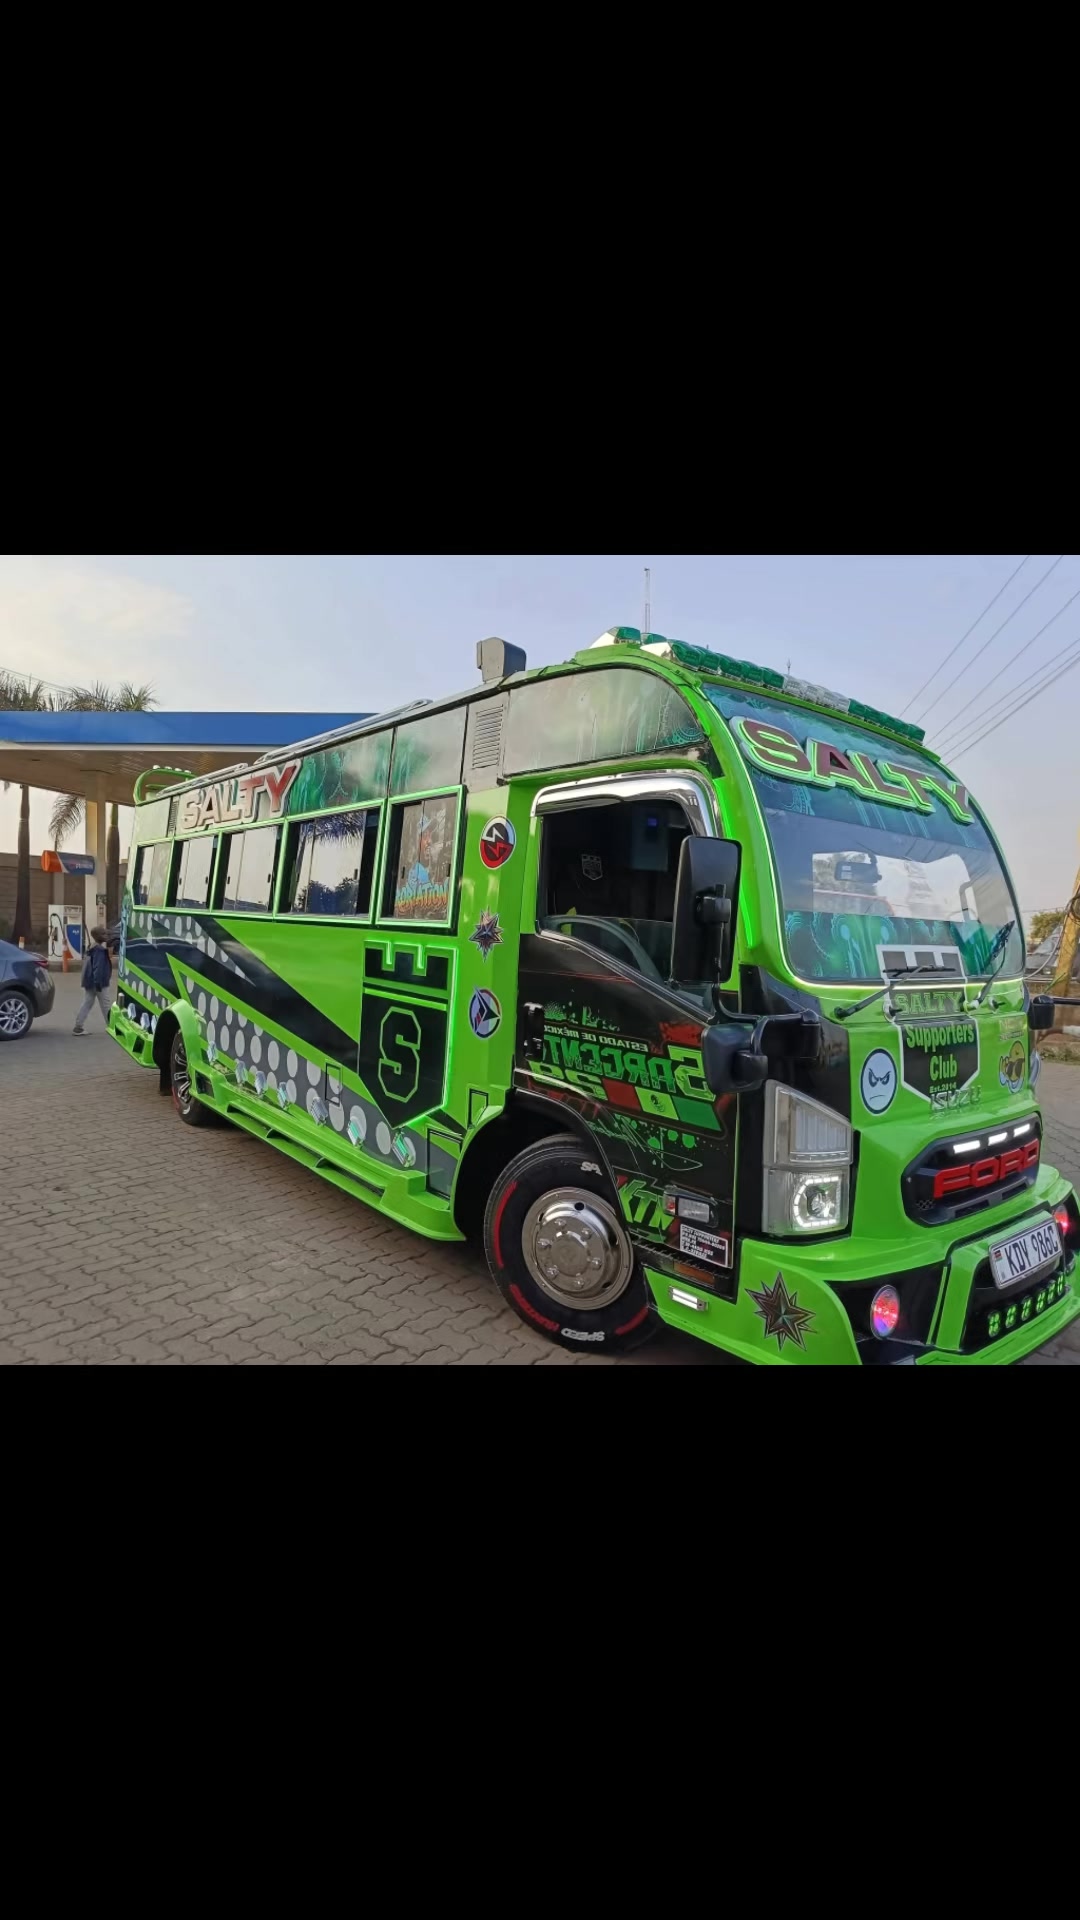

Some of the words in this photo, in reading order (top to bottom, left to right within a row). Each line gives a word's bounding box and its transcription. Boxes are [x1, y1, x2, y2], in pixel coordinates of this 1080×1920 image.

[735, 717, 972, 822] SALTY
[179, 762, 299, 831] SALTY
[895, 991, 962, 1015] SALTY
[905, 1022, 975, 1053] Supporters
[929, 1054, 958, 1081] Club
[930, 1085, 981, 1111] ISUZU
[934, 1138, 1040, 1199] FORD
[1004, 1238, 1031, 1276] KDY
[1031, 1225, 1059, 1262] 986C
[561, 1327, 605, 1342] SPEED
